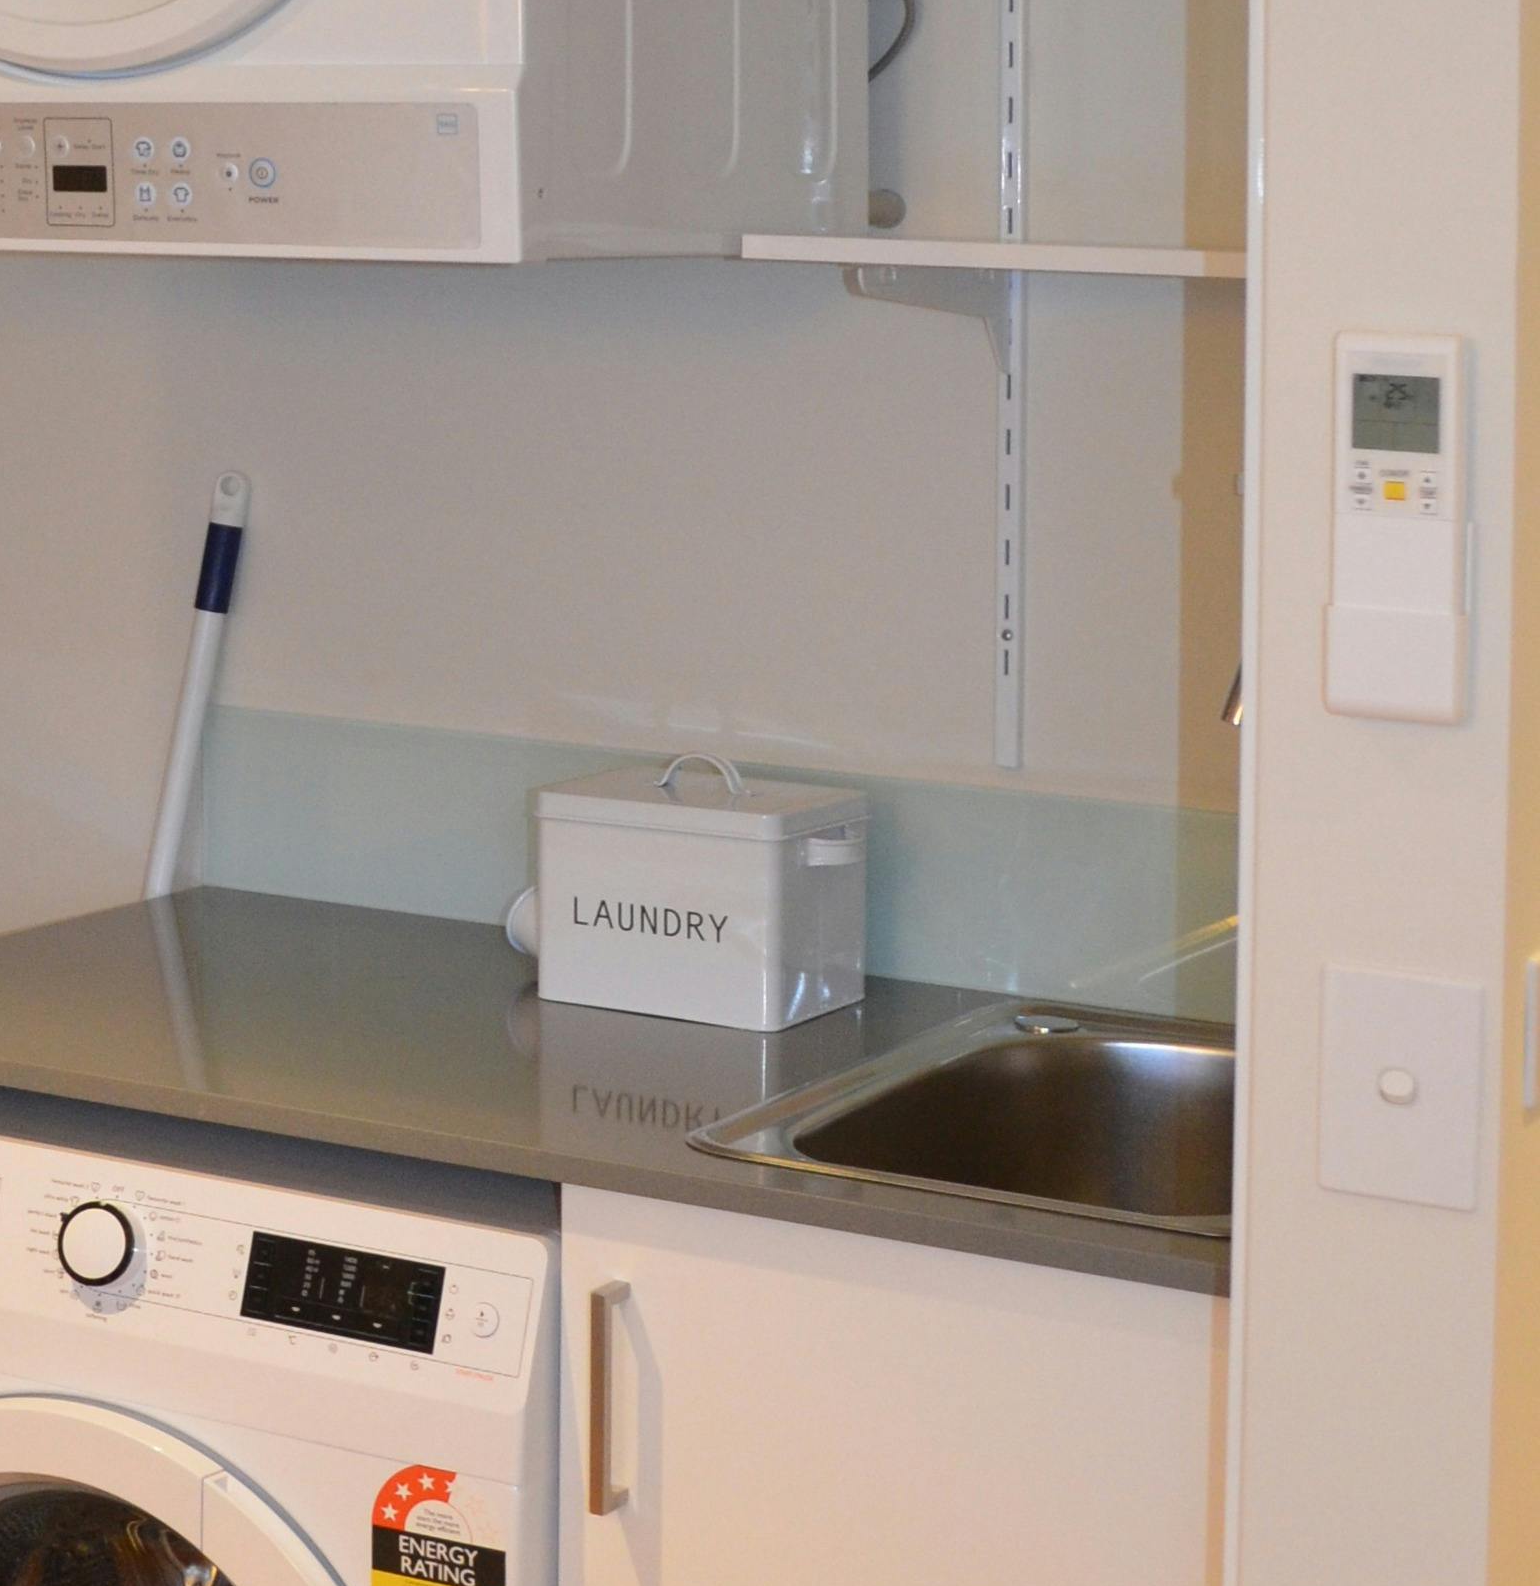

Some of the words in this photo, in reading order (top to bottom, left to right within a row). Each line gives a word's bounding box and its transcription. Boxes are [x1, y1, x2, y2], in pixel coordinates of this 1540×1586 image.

[248, 196, 279, 204] POWER
[572, 896, 729, 943] LAUNDRY
[398, 1534, 478, 1567] ENERGY
